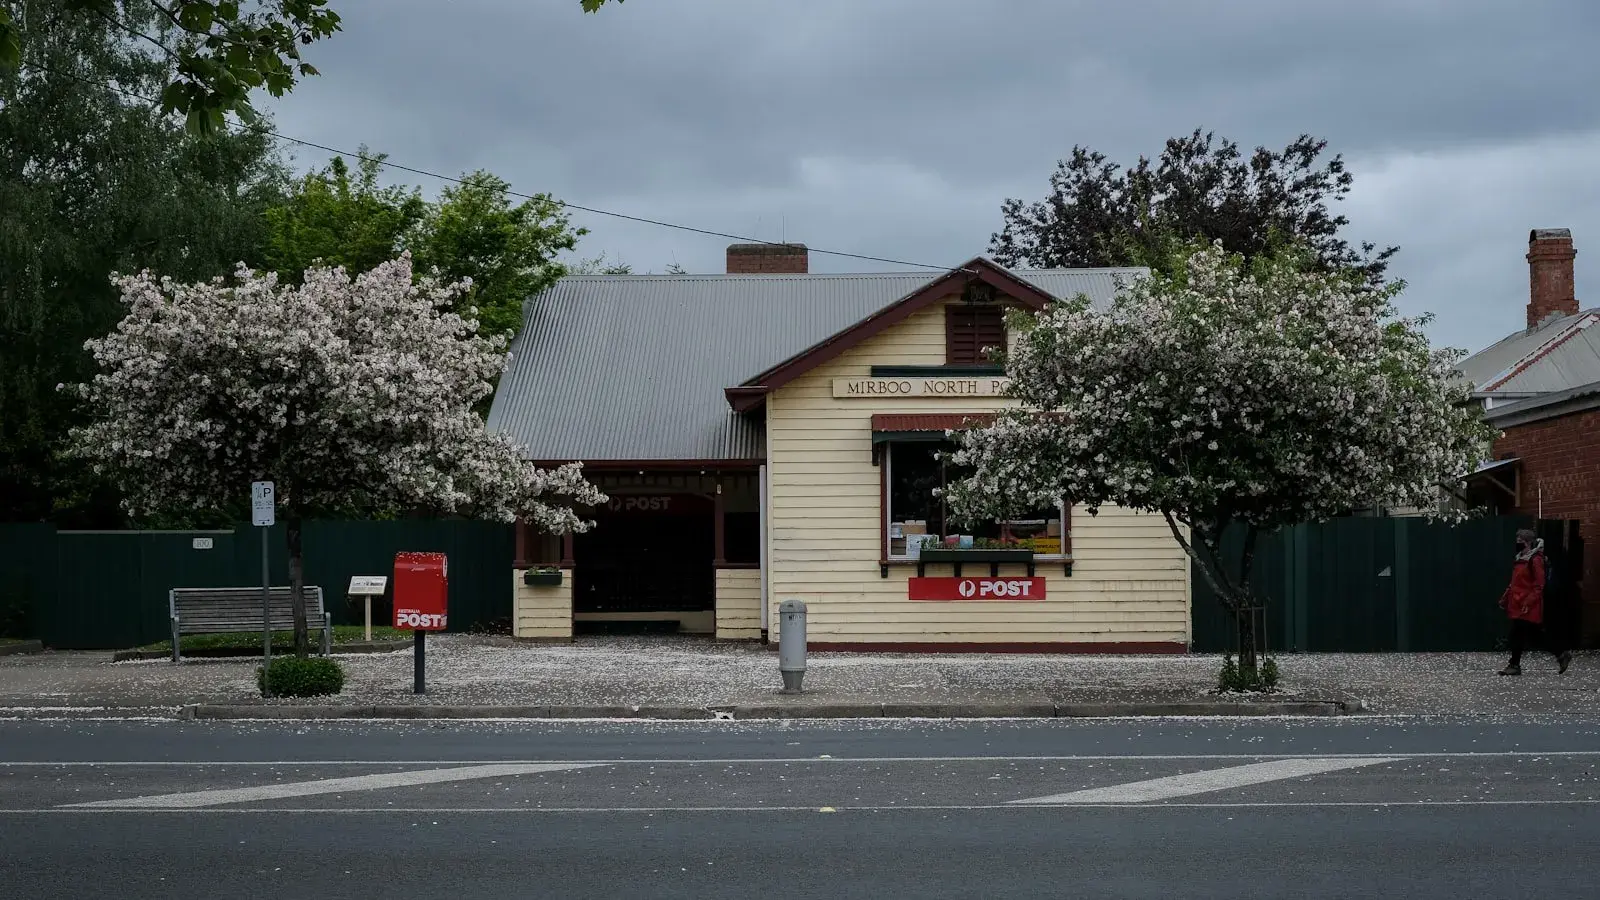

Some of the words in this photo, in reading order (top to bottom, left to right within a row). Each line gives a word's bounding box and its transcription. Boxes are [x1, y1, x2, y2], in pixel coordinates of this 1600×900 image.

[847, 380, 912, 394] MIRBOO
[923, 380, 978, 394] NORTH
[625, 496, 672, 511] POST
[980, 580, 1033, 597] POST
[396, 613, 442, 628] POST
